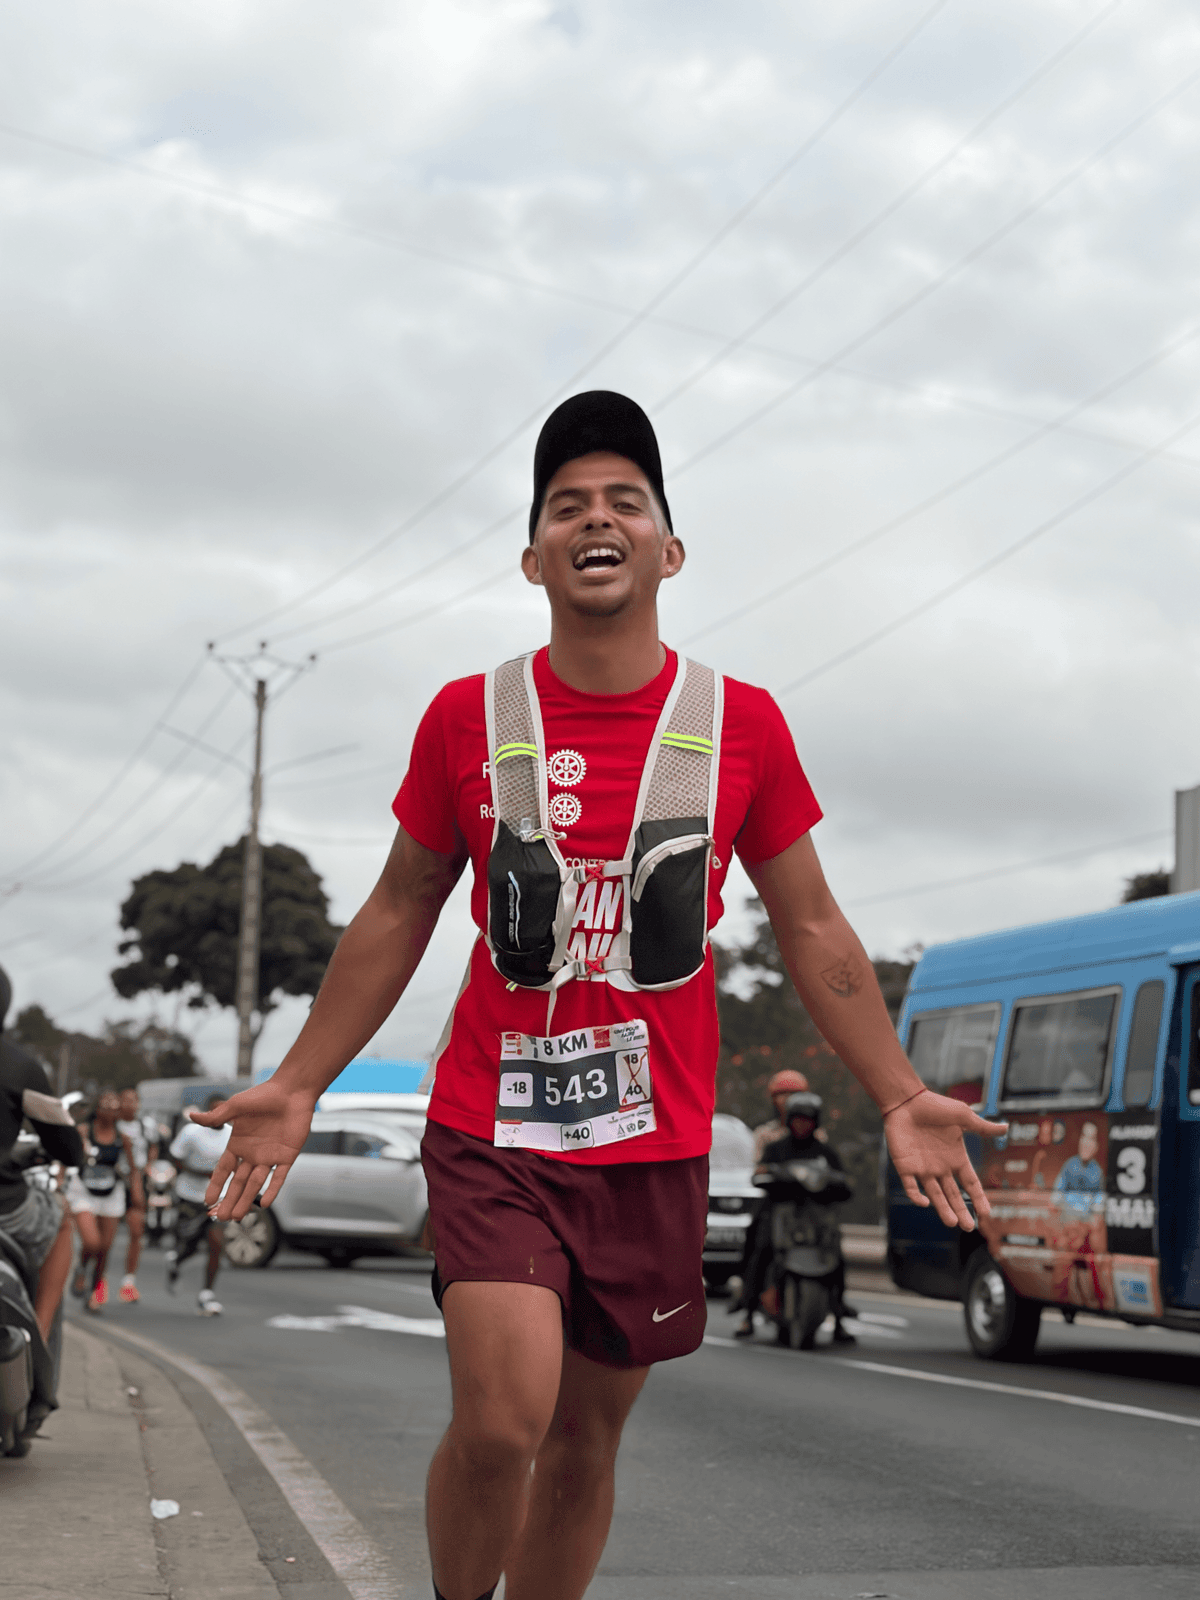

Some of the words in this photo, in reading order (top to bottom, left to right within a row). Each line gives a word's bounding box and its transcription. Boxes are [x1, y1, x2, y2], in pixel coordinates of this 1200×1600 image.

[558, 1033, 588, 1055] KM
[506, 1081, 527, 1094] -18
[544, 1068, 608, 1106] 543
[564, 1126, 590, 1141] +40
[1116, 1146, 1147, 1194] 3
